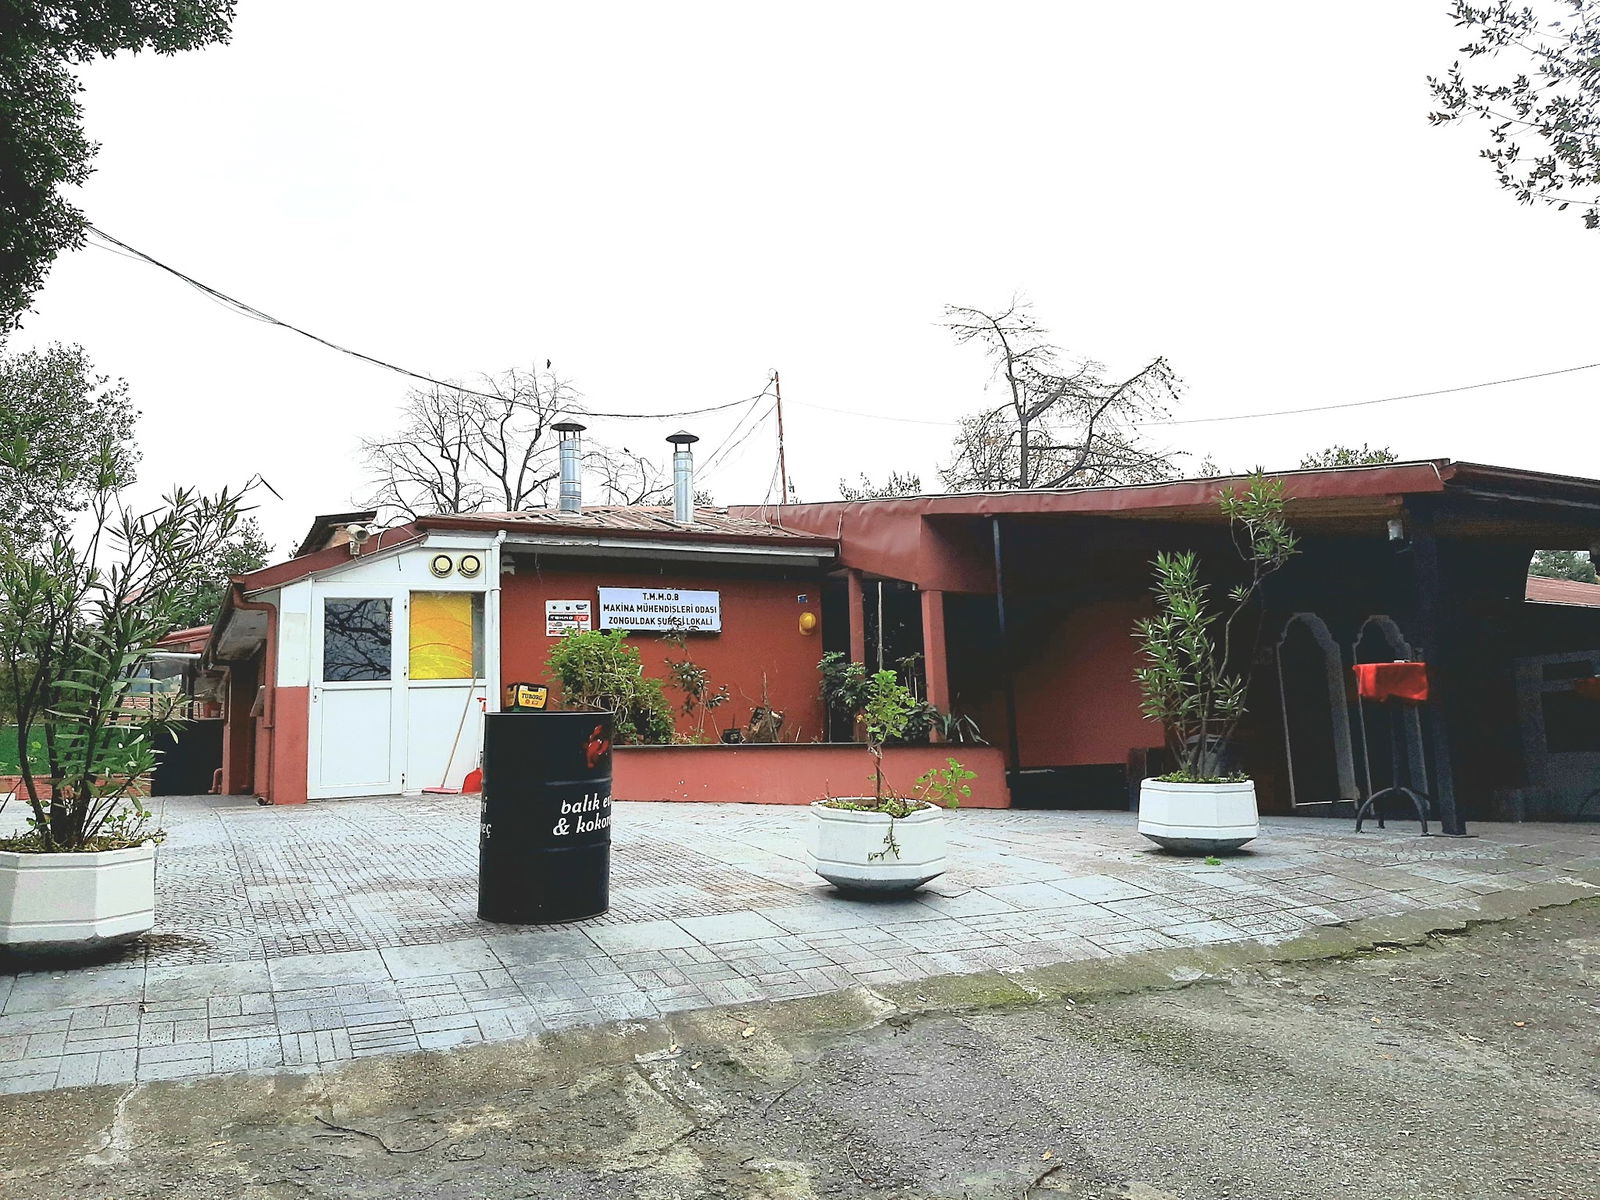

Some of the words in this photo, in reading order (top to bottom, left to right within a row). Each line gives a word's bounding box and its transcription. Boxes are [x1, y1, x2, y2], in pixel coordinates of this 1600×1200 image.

[642, 592, 679, 601] T.M.M.O.B
[603, 601, 635, 613] MAKİNA
[636, 602, 694, 614] MÜHENDİSLERİ
[695, 605, 717, 614] ODASI
[608, 616, 658, 625] ZONGULDAK
[686, 616, 713, 626] LOKALİ
[560, 792, 600, 815] balık
[552, 817, 570, 836] &
